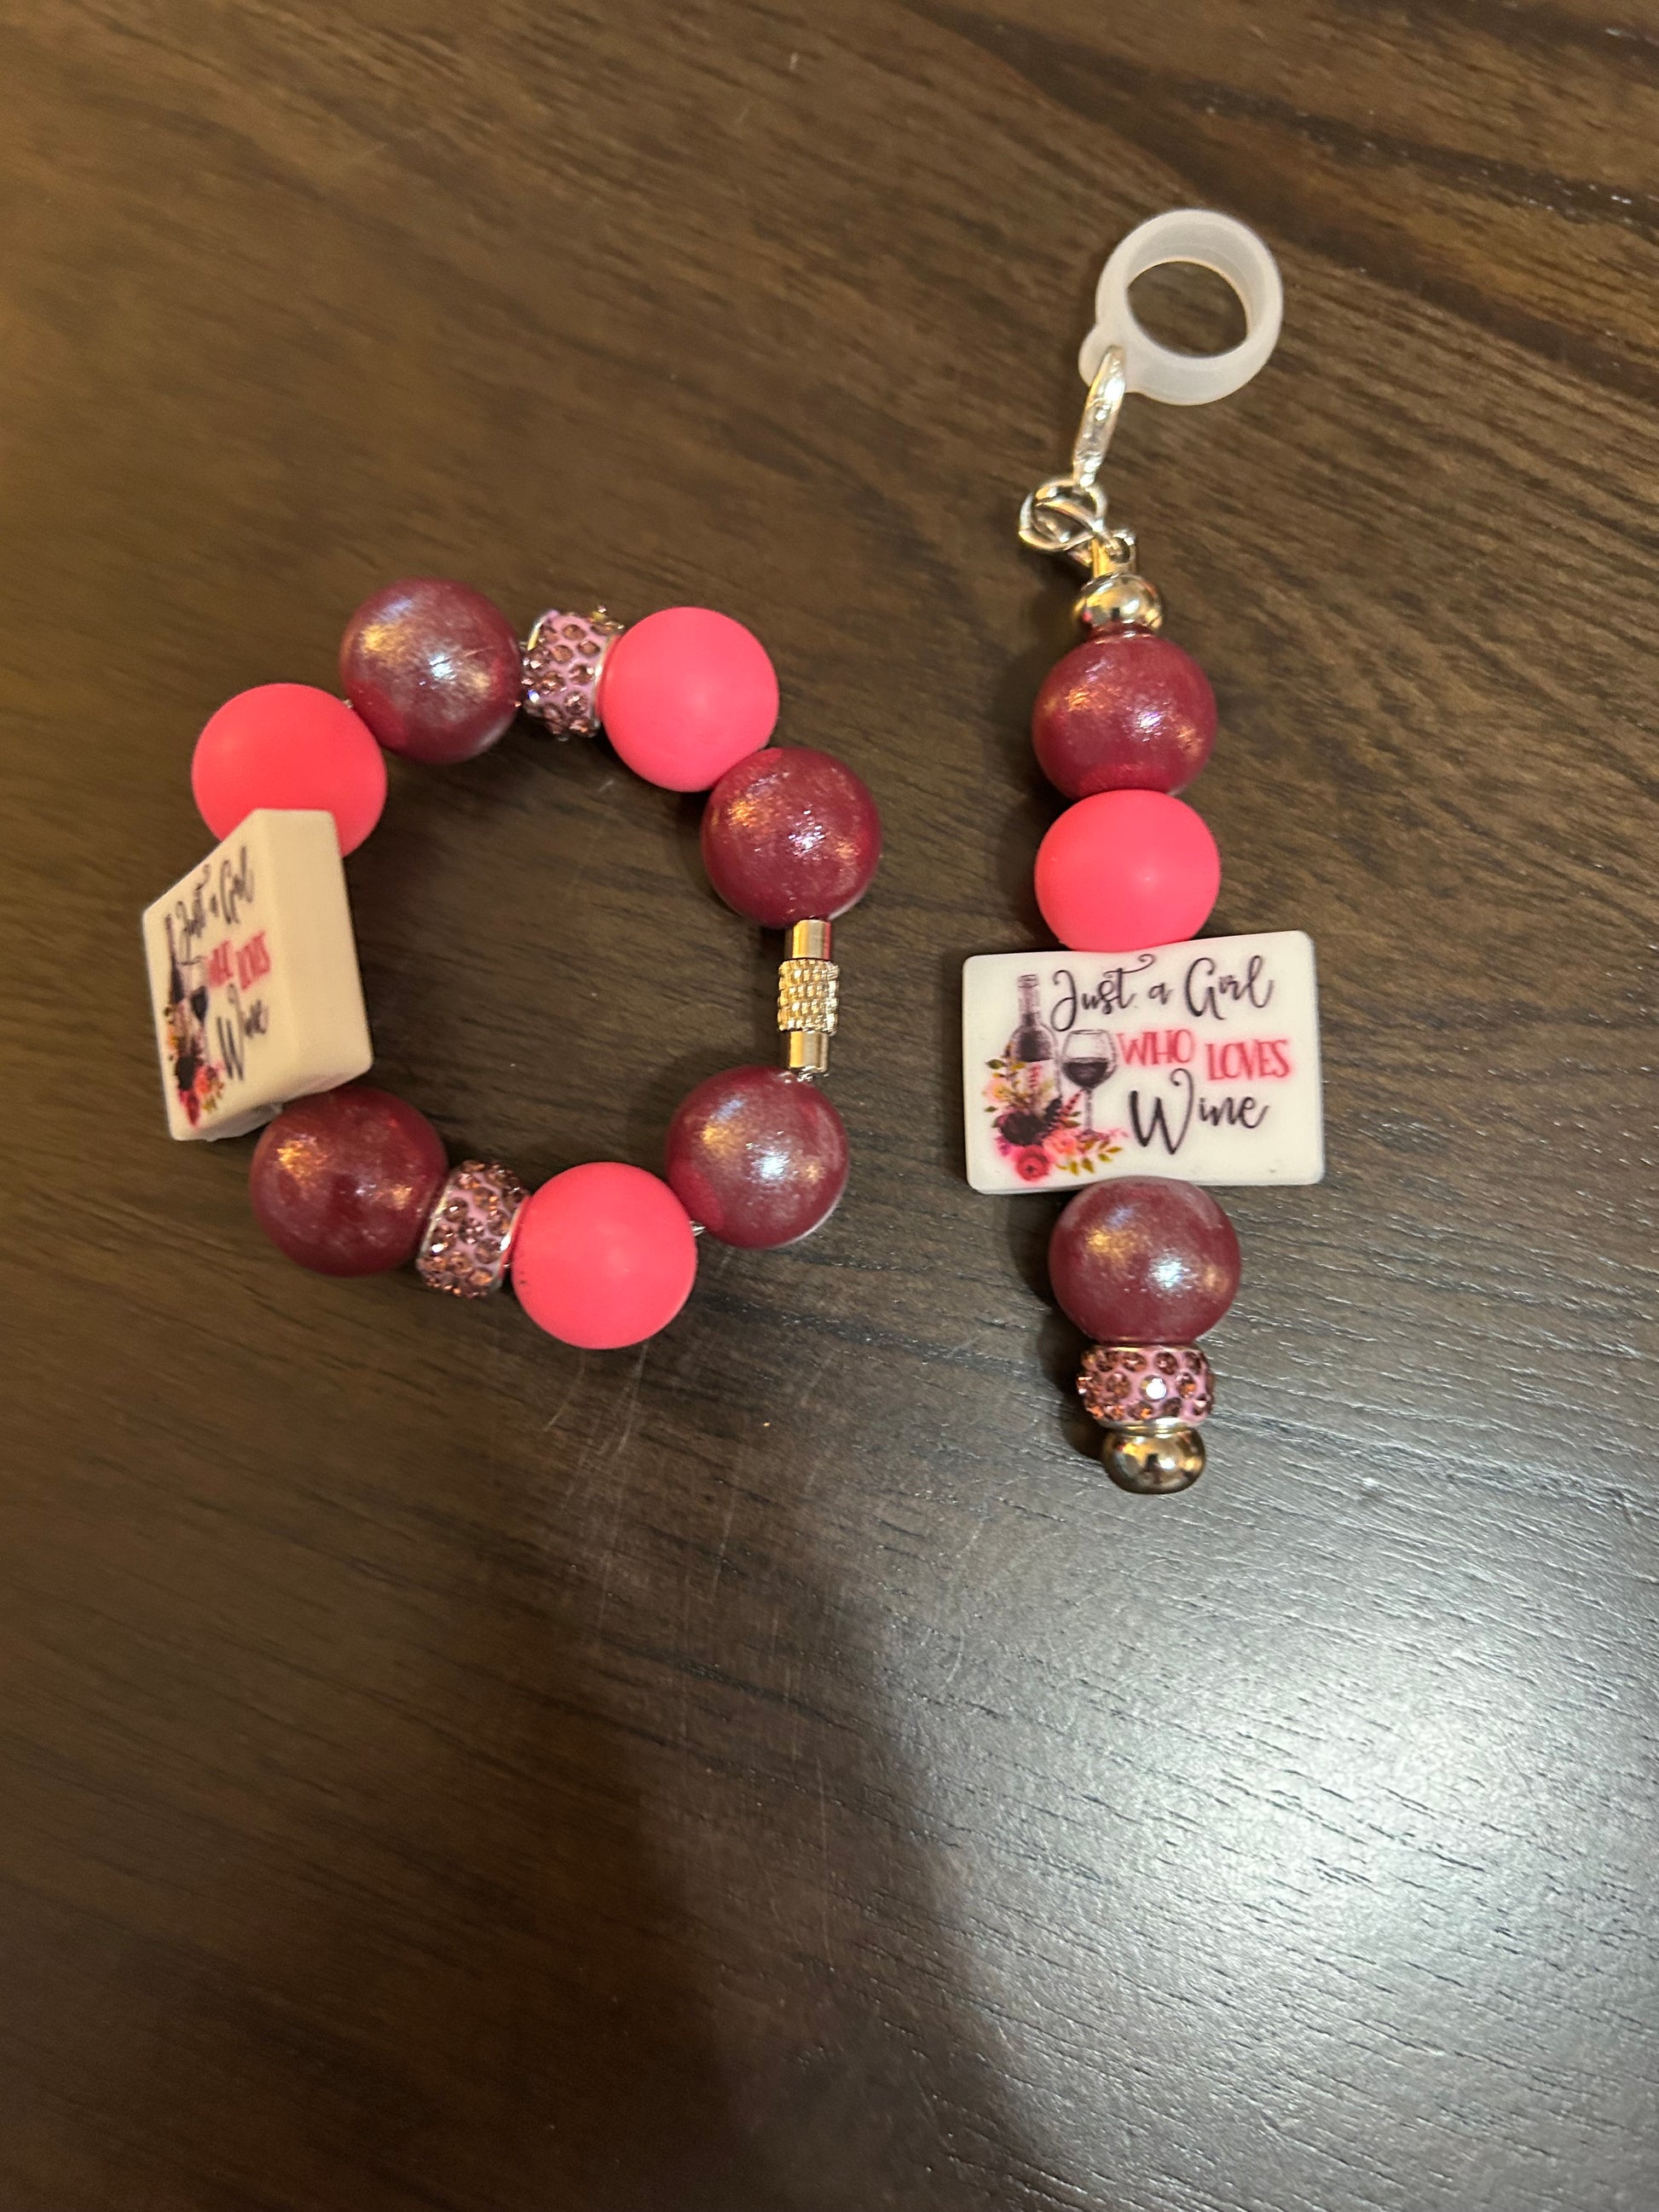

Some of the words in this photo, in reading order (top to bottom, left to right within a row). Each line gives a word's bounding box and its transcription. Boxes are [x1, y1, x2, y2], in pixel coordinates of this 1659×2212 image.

[1050, 954, 1155, 1031] Just
[1148, 980, 1172, 1004] a
[1184, 955, 1274, 1019] Girl
[1118, 1030, 1194, 1066] WHO
[1206, 1040, 1291, 1080] LOVES
[1129, 1069, 1269, 1155] Wine
